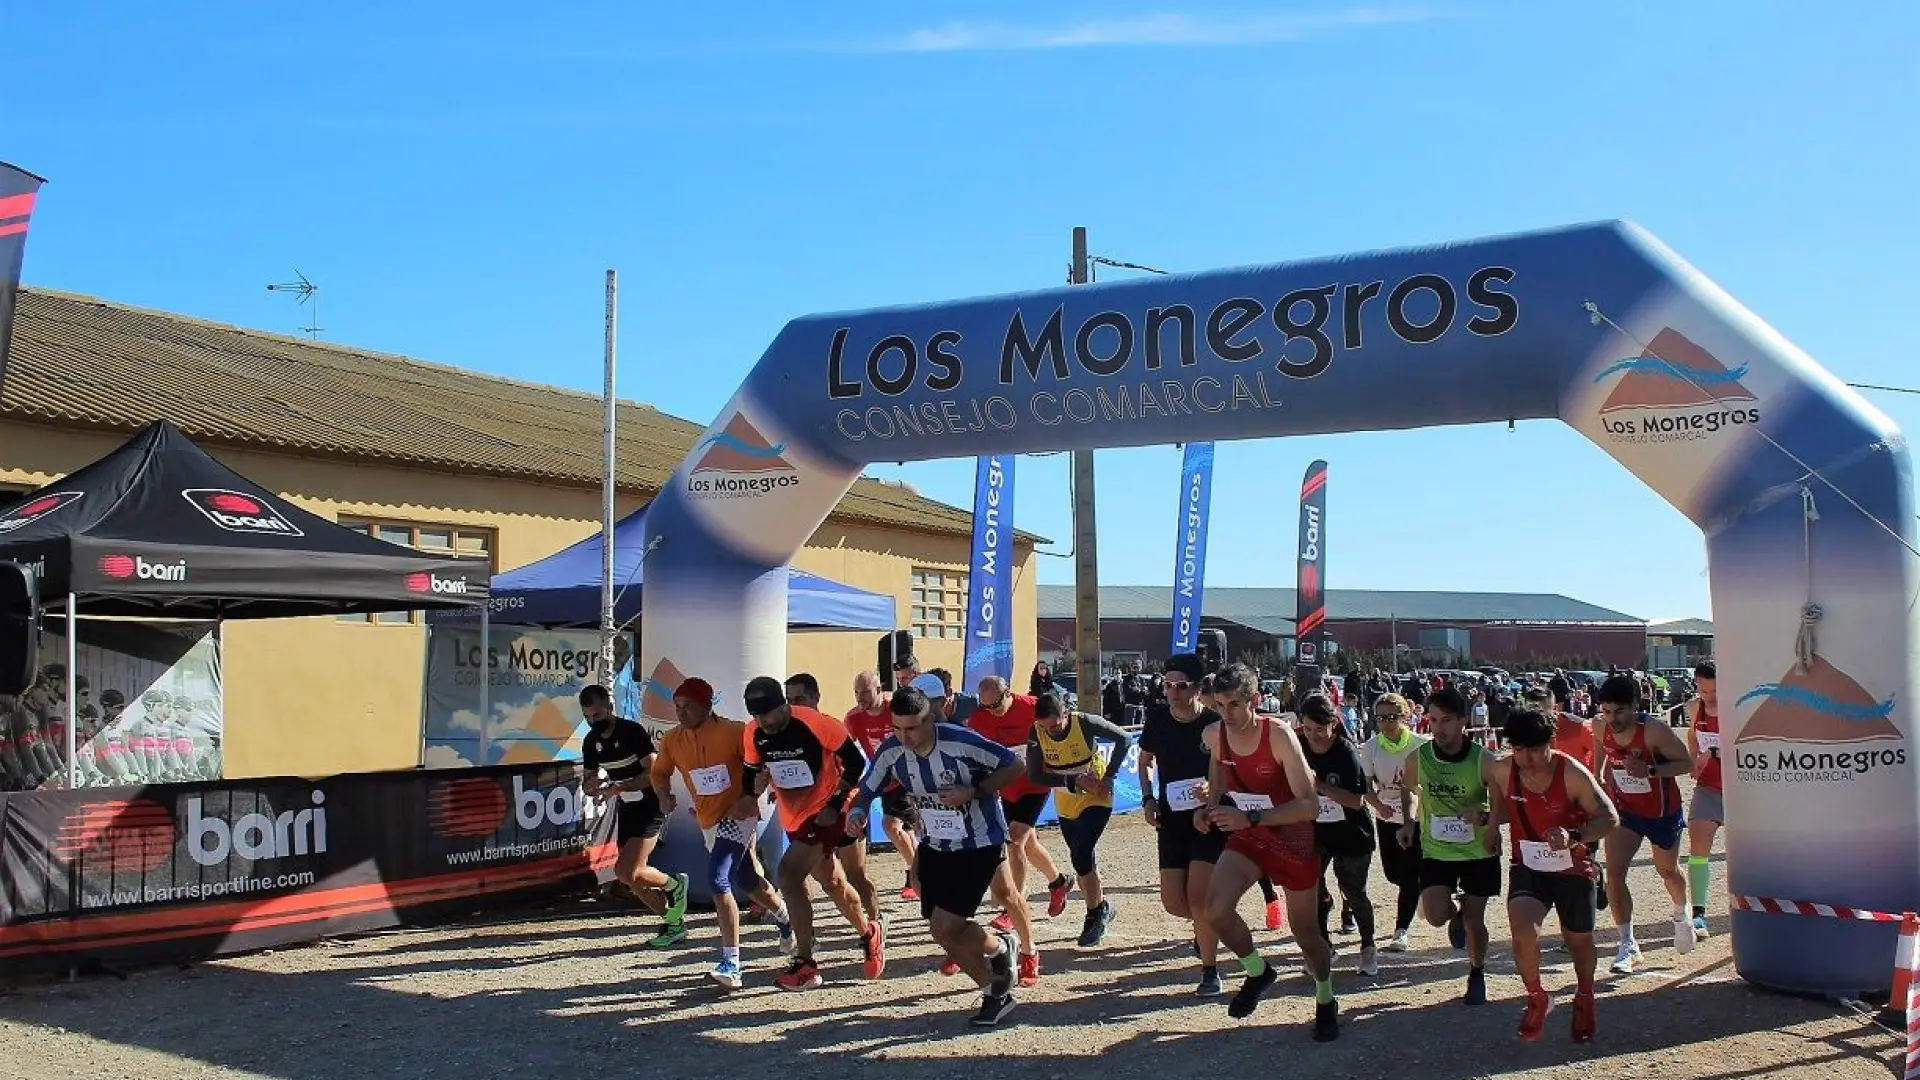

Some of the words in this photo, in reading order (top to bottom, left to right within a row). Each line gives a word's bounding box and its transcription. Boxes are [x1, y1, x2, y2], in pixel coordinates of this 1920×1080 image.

[828, 328, 963, 399] Los
[999, 266, 1520, 379] Monegros
[836, 396, 1018, 442] CONSEJO
[1030, 371, 1282, 425] COMARCAL
[1602, 417, 1636, 434] Los
[1643, 408, 1760, 433] Monegros
[1651, 430, 1708, 444] COMARCAL
[687, 477, 710, 492] Los
[714, 474, 800, 493] Monegros
[209, 510, 291, 531] barri
[982, 455, 1004, 575] Monegr
[1302, 504, 1320, 562] barri
[1179, 472, 1201, 599] Monegros
[136, 555, 187, 581] barri
[430, 573, 467, 593] barri
[976, 586, 996, 639] Los
[1175, 605, 1193, 649] Los
[454, 670, 512, 686] CONEJO
[508, 641, 602, 678] Monegr
[1736, 748, 1769, 770] Los
[1777, 748, 1907, 774] Monegros
[1737, 770, 1781, 783] CONSEJO
[1785, 769, 1856, 783] COMARCAL
[187, 789, 327, 867] barri
[87, 869, 315, 908] www.barrisportline.com
